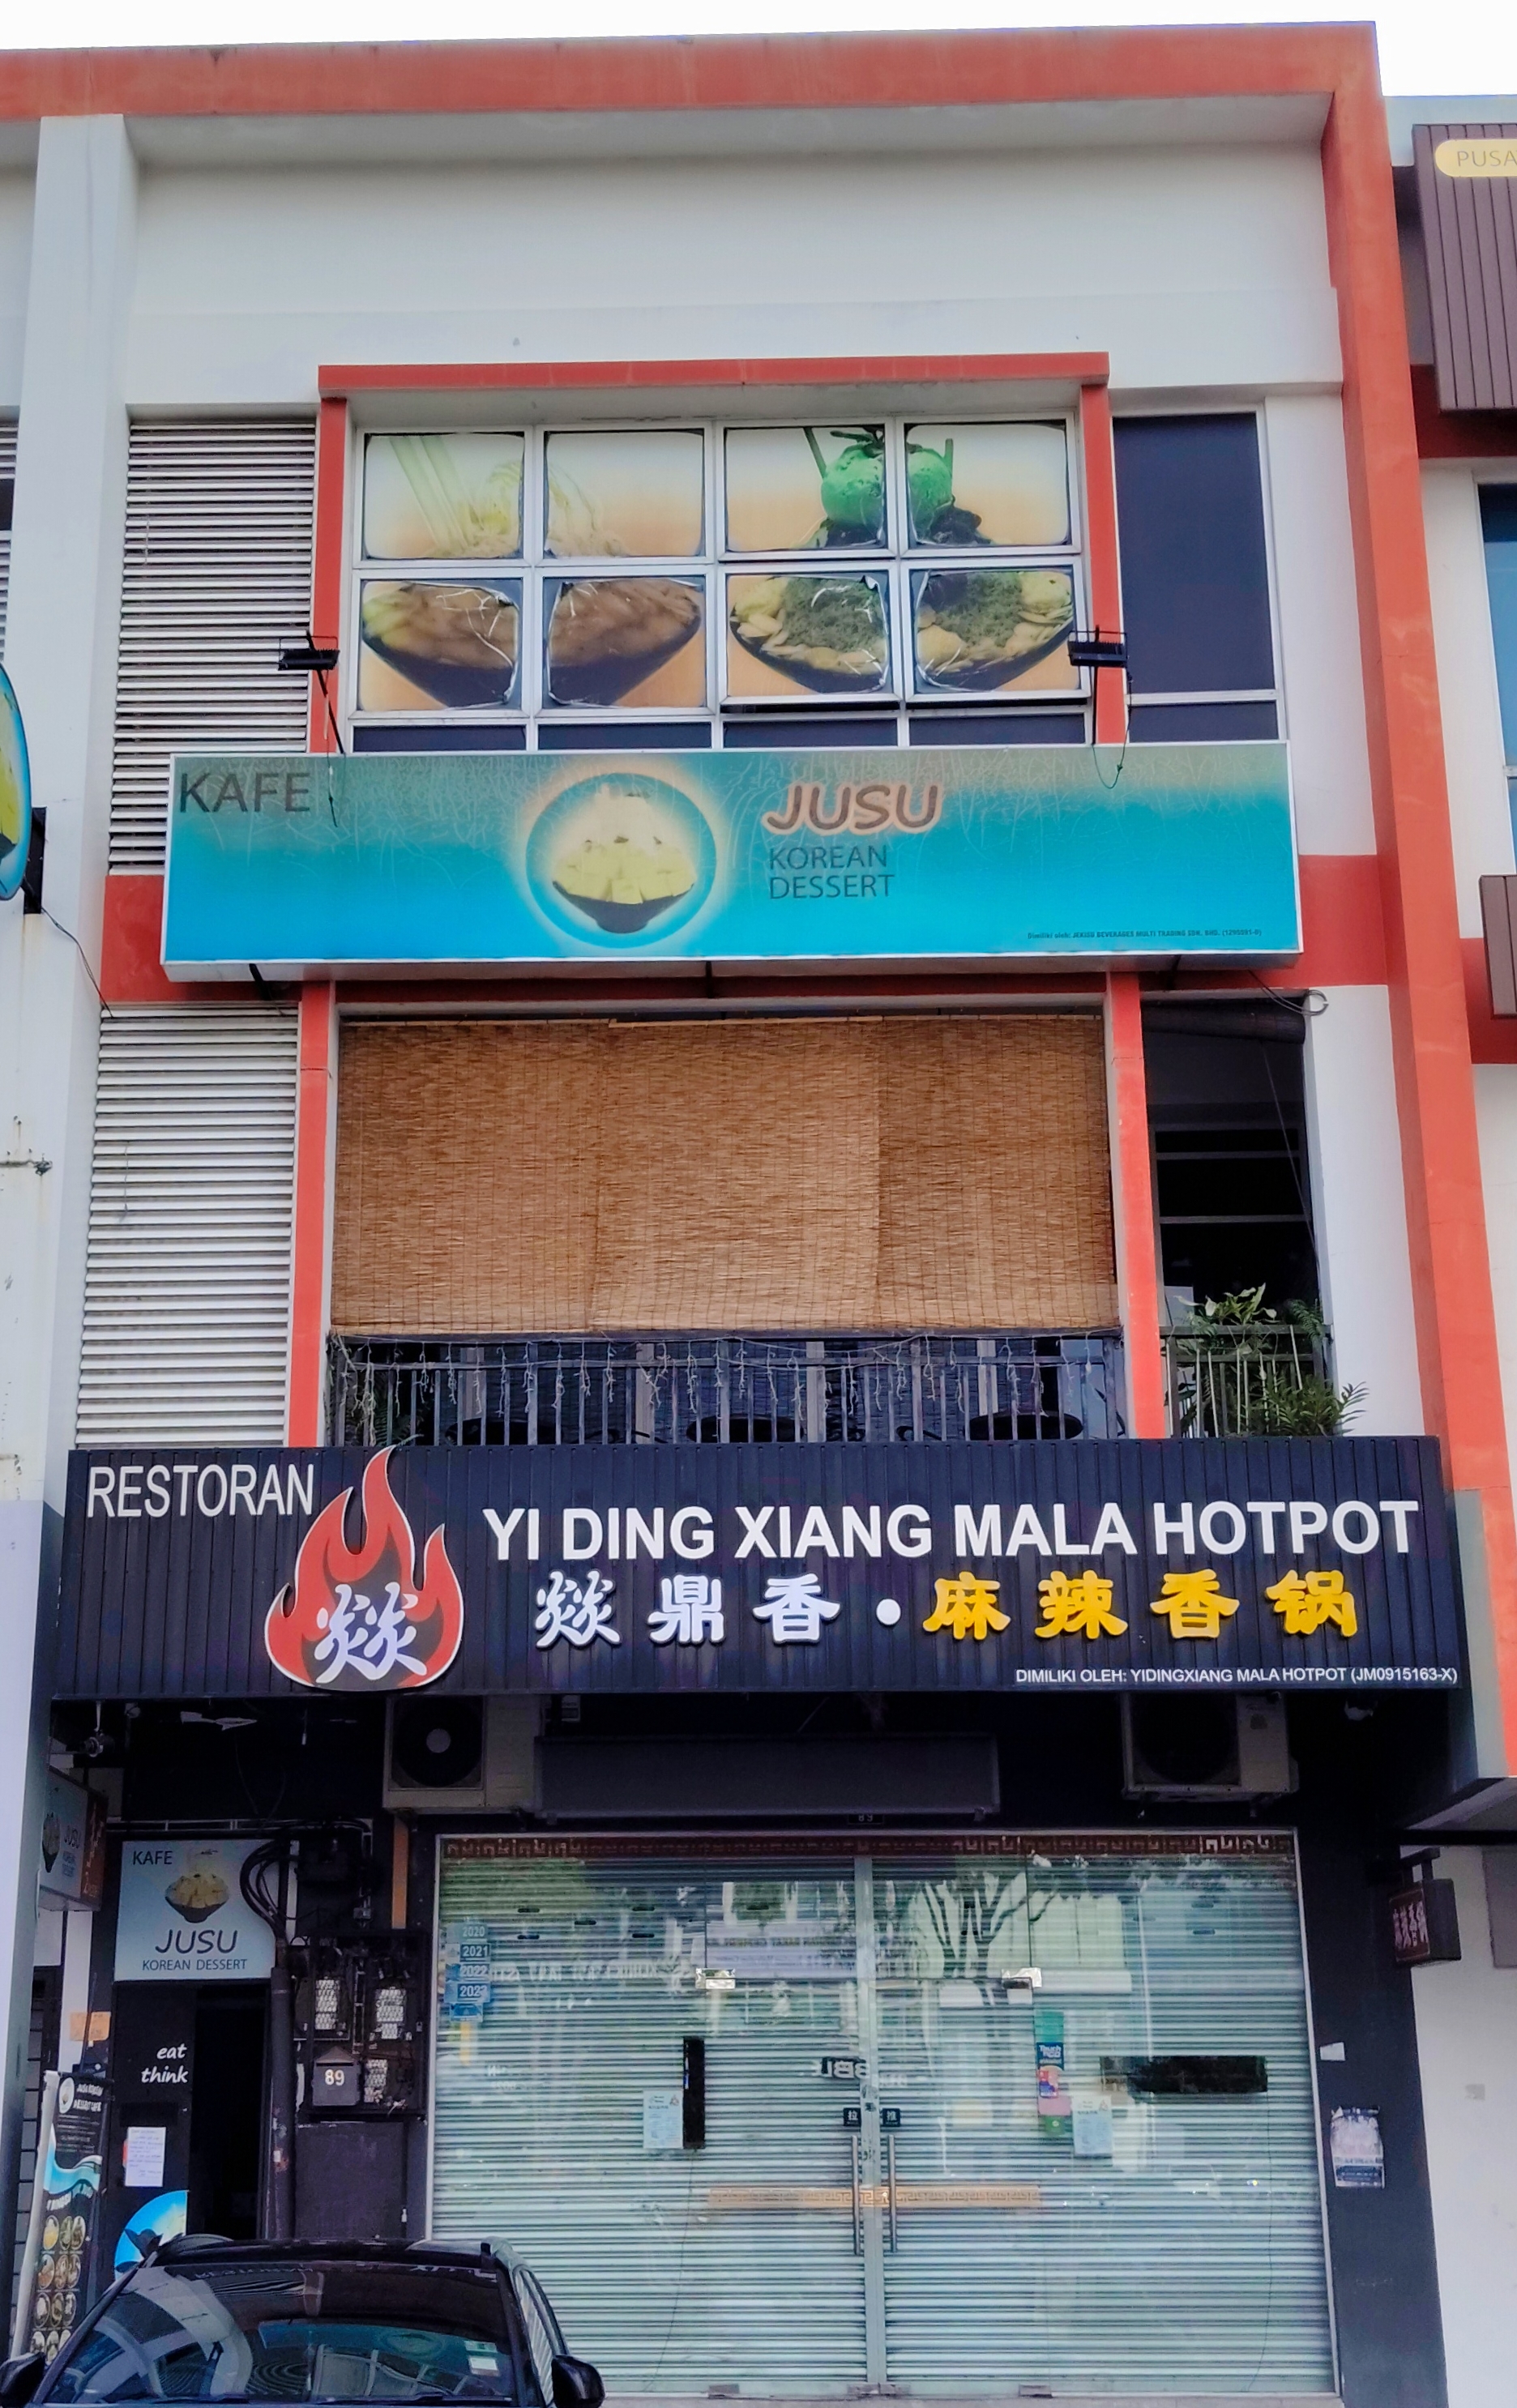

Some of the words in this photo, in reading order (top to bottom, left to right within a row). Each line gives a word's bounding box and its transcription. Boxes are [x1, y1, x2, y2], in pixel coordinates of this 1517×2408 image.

[1457, 150, 1517, 167] PUSA
[180, 772, 311, 813] KAFE
[765, 783, 940, 832] JUSU
[770, 845, 887, 870] KOREAN
[770, 874, 895, 899] DESSERT
[88, 1463, 314, 1518] RESTORAN
[483, 1507, 540, 1561] YI
[562, 1506, 714, 1560] DING
[734, 1505, 932, 1559] XIANG
[955, 1503, 1138, 1557] MALA
[1152, 1501, 1419, 1555] HOTPOT
[922, 1569, 1359, 1640] 麻辣香锅
[1016, 1669, 1076, 1683] DIMILIKI
[1080, 1669, 1127, 1683] OLEH:
[1130, 1669, 1233, 1683] YIDINGXIANG
[1237, 1668, 1280, 1683] MALA
[1282, 1667, 1347, 1682] HOTPOT
[1350, 1667, 1458, 1684] (JM0915163-X)
[133, 1851, 173, 1865] KAFE
[462, 1926, 485, 1937] 2020
[155, 1929, 238, 1954] JUSU
[462, 1945, 489, 1958] 2021
[142, 1959, 190, 1970] KOREAN
[196, 1958, 248, 1970] DESSERT
[156, 2043, 187, 2059] eat
[141, 2065, 189, 2083] think
[325, 2069, 345, 2086] 89
